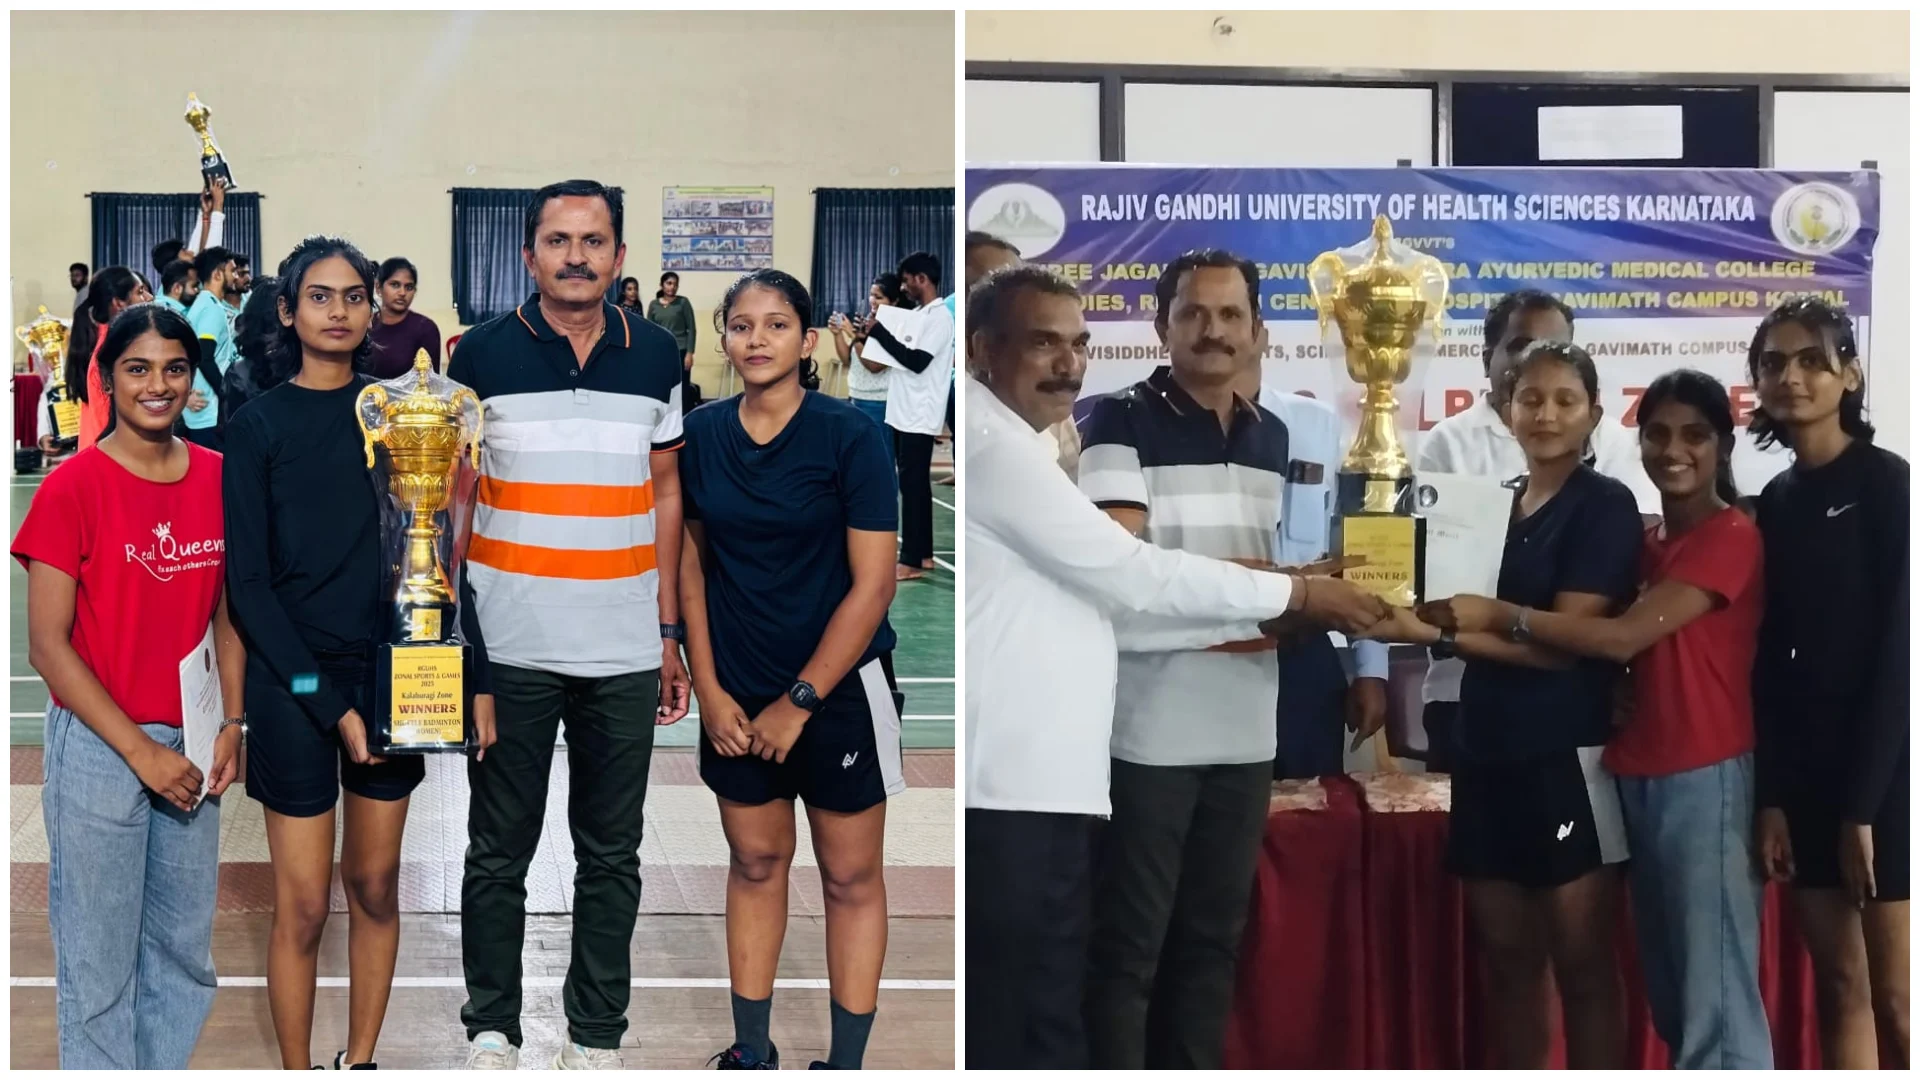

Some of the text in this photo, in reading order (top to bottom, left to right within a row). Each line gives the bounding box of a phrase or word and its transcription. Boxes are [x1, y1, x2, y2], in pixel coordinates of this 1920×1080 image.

[1081, 194, 1756, 222] RAJIV GANDHI UNIVERSITY OF HEALTH SCIENCES KARNATAKA
[1477, 262, 1604, 279] AYURVEDIC
[1612, 261, 1709, 279] MEDICAL
[1715, 260, 1816, 279] COLLEGE
[1667, 291, 1759, 308] CAMPUS
[1586, 341, 1672, 356] GAVIMATH
[1679, 340, 1749, 355] COMPUS
[1350, 571, 1409, 581] WINNERS
[398, 703, 457, 714] WINNERS
